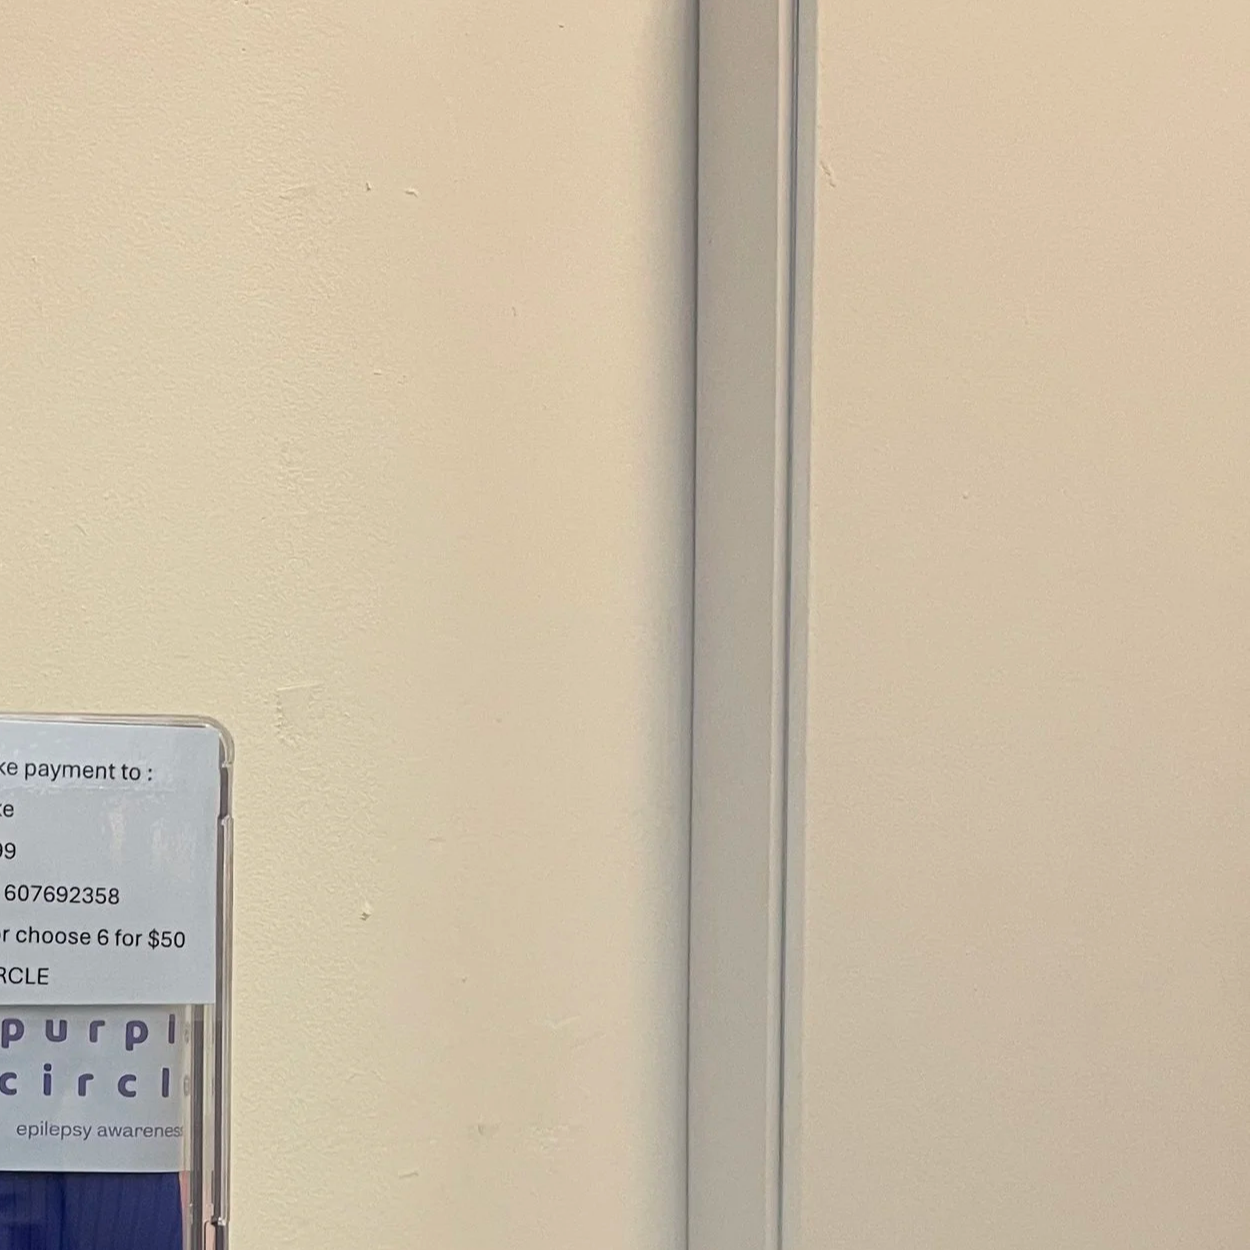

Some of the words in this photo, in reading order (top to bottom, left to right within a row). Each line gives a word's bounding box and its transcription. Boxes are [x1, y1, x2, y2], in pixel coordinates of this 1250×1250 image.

[24, 762, 116, 782] payment
[121, 765, 141, 781] to
[4, 884, 120, 905] 607692358
[15, 926, 91, 945] choose
[97, 929, 109, 946] 6
[114, 929, 143, 947] for
[147, 929, 186, 950] $50
[16, 1121, 93, 1140] epilepsy
